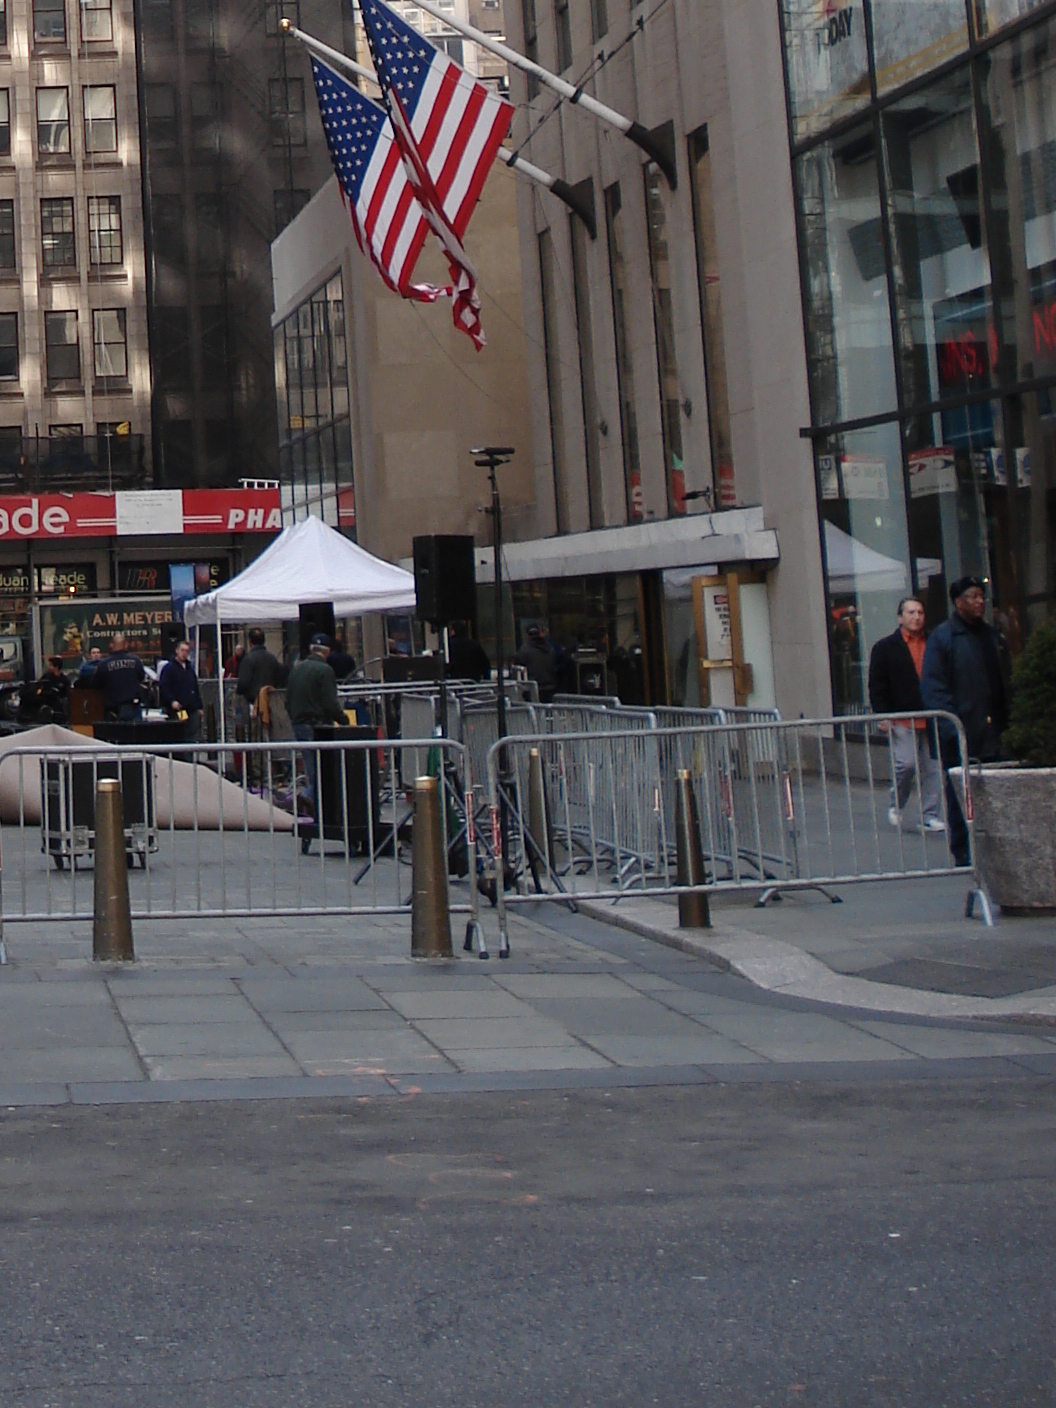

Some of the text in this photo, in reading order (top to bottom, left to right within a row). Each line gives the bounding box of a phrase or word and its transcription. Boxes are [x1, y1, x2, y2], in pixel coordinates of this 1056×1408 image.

[227, 508, 282, 530] PHA
[92, 611, 172, 626] A.W. MEYER
[87, 629, 147, 638] Contractors
